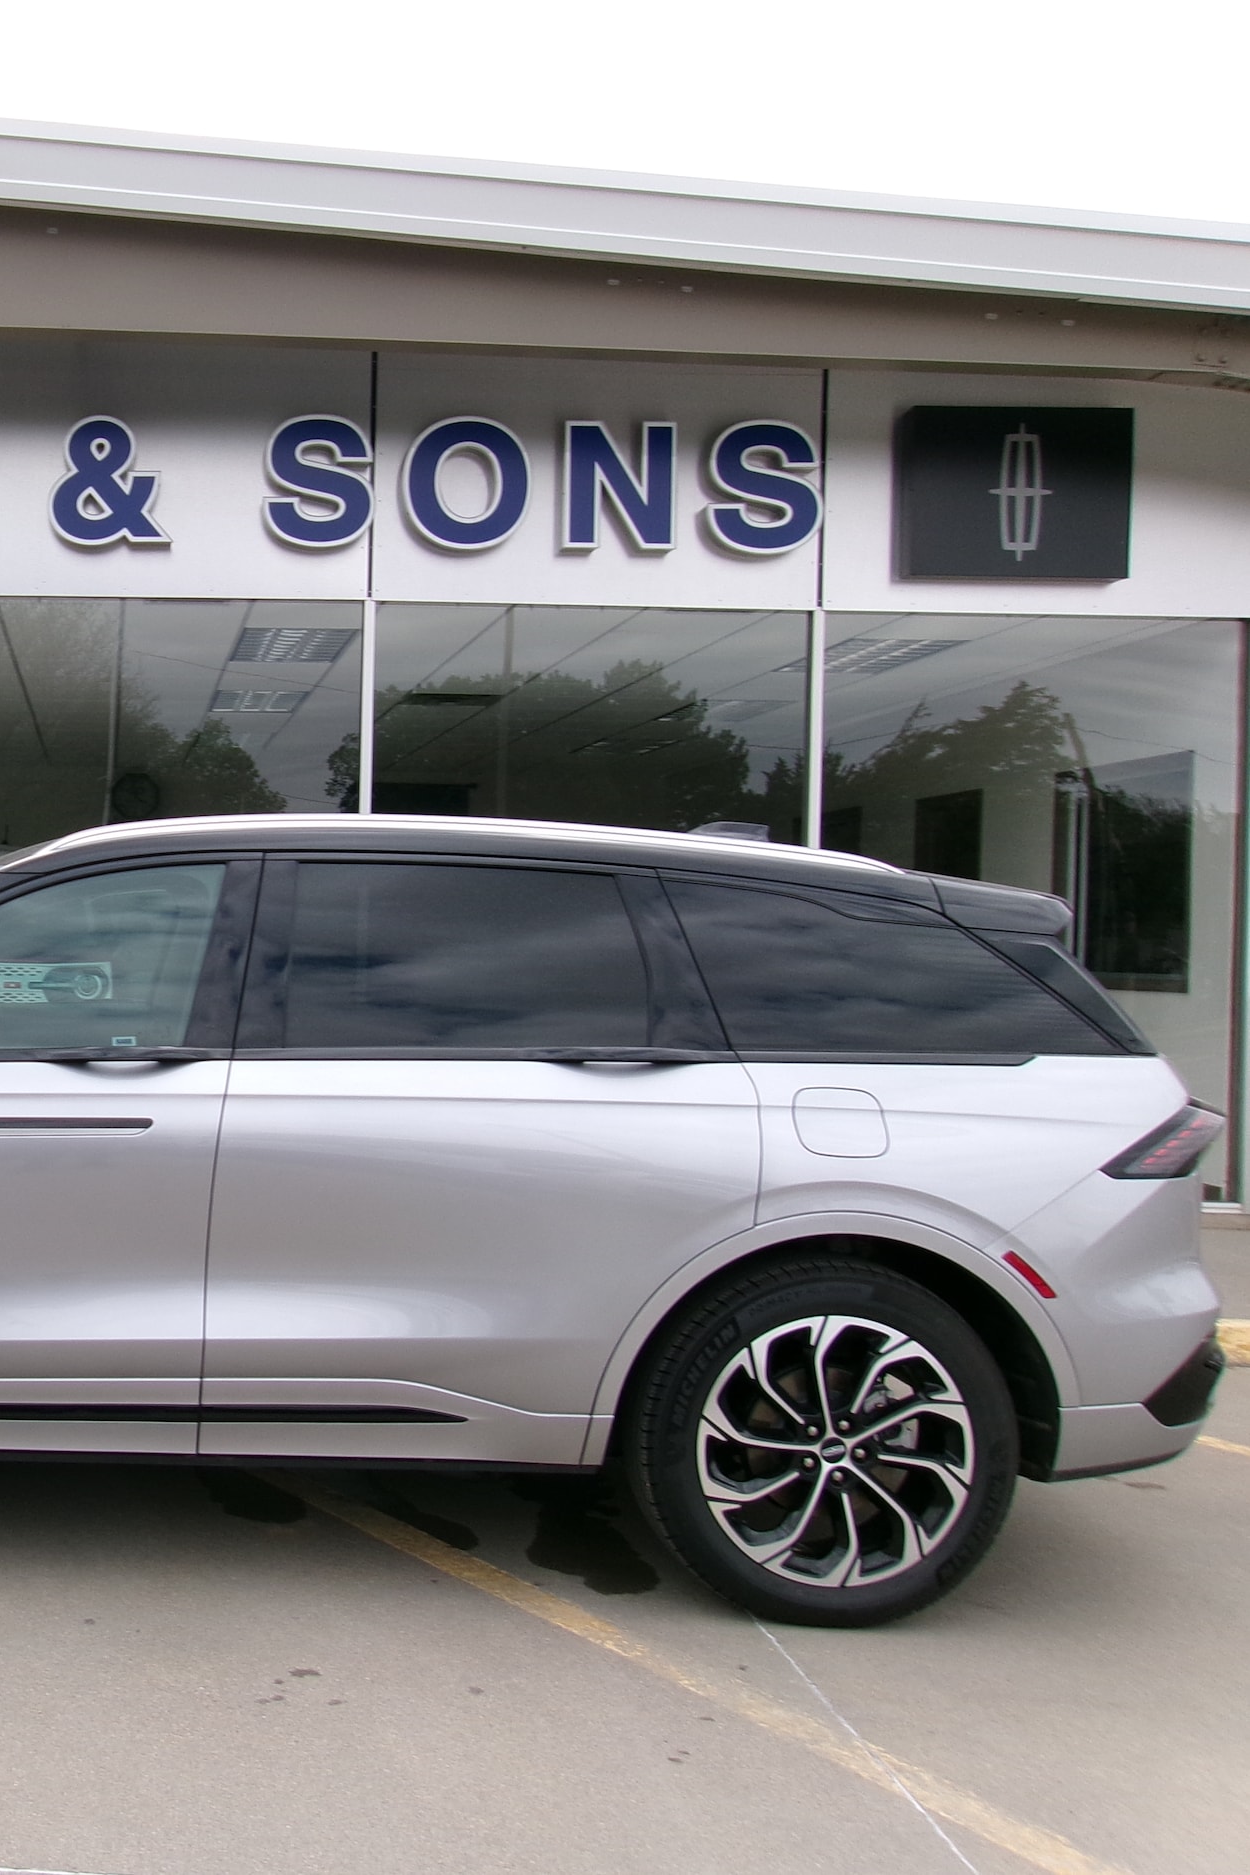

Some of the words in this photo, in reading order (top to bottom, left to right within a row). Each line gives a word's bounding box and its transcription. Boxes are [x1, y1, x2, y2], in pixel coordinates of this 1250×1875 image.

[49, 413, 173, 547] &
[261, 413, 826, 556] SONS
[671, 1320, 740, 1429] MICHELIN
